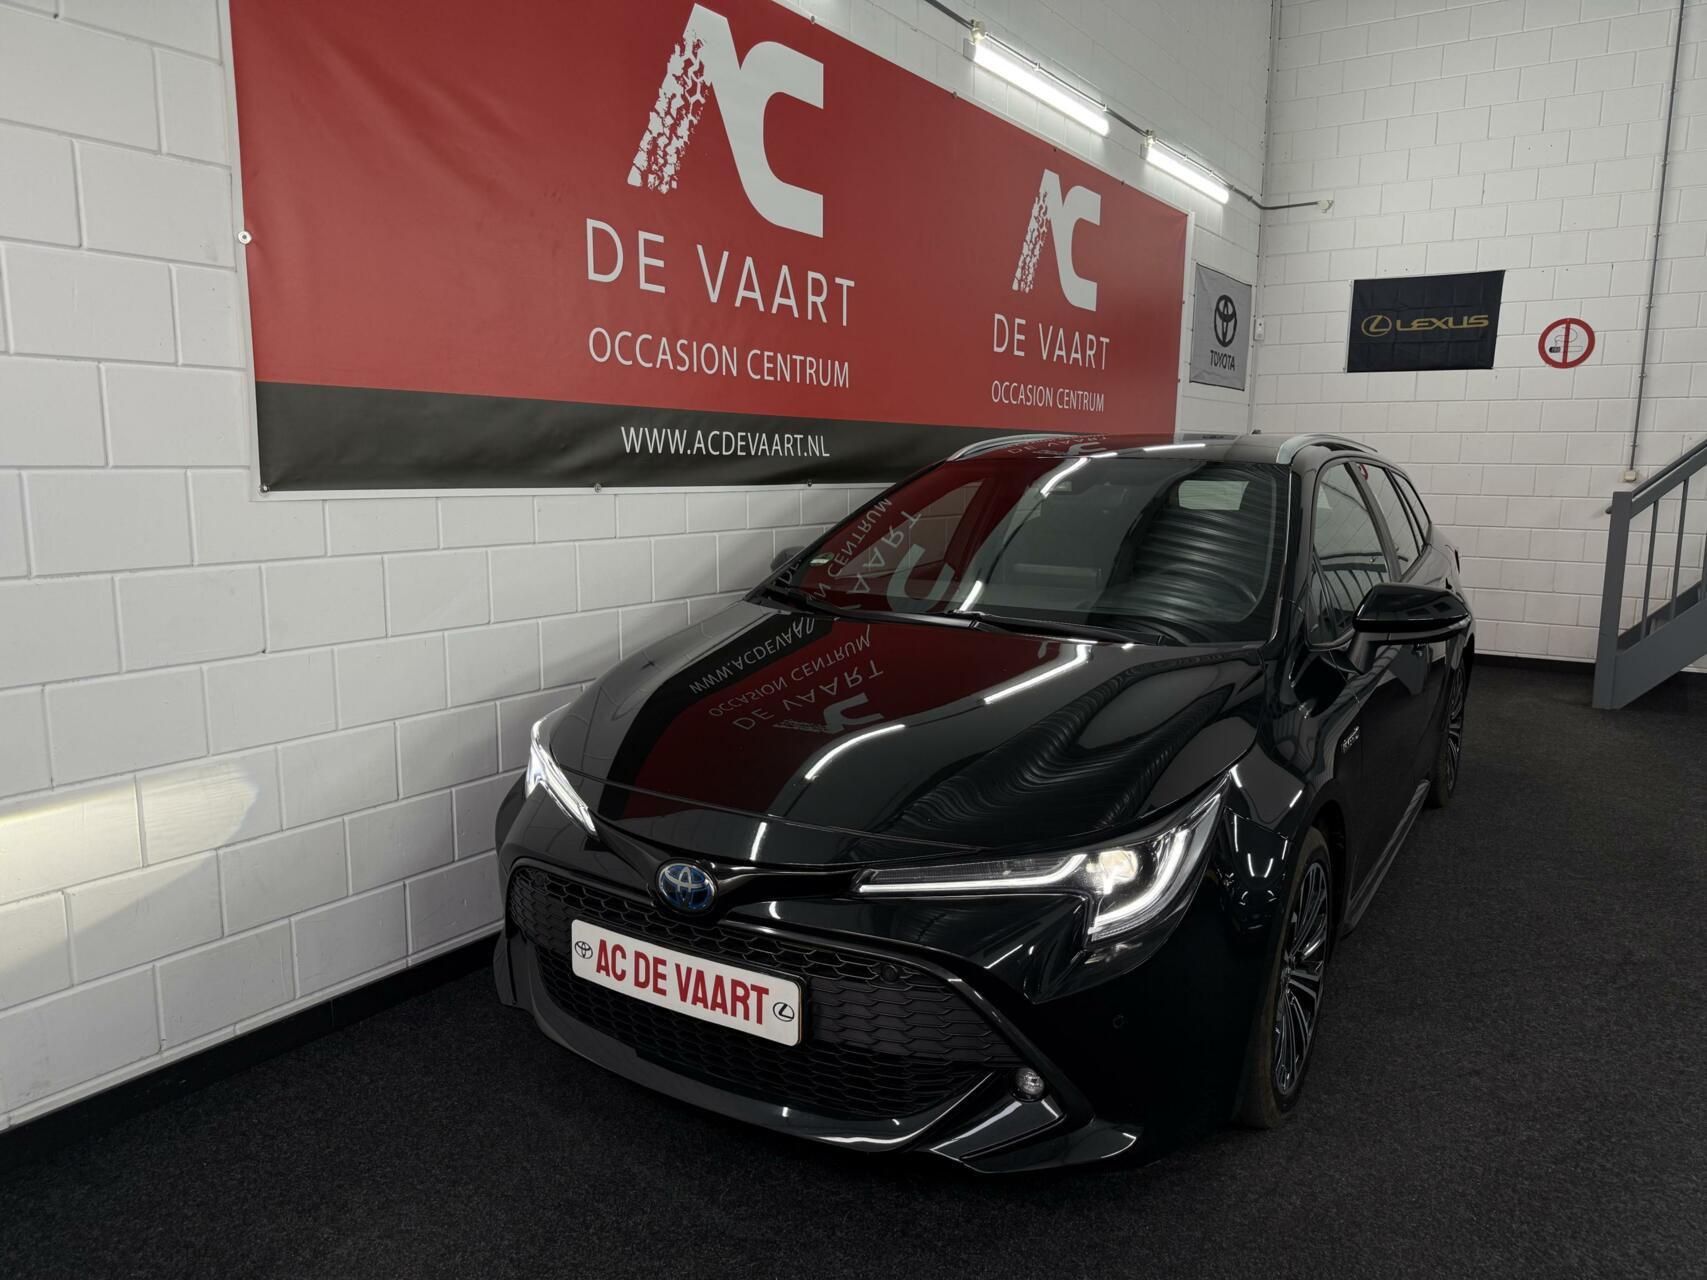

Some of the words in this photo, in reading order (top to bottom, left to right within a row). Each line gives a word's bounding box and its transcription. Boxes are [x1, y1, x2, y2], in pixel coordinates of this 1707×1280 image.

[586, 217, 666, 295] DE
[696, 243, 855, 327] VAART
[992, 313, 1026, 356] DE
[1038, 323, 1110, 371] VAART
[1396, 314, 1489, 331] LEXUS
[588, 327, 738, 377] OCCASION
[747, 348, 850, 389] CENTRUM
[1210, 349, 1236, 371] TOYOTA
[991, 380, 1054, 408] OCCASION
[1056, 389, 1105, 413] CENTRUM
[621, 425, 830, 457] WWW.ACDEVAART.NL
[596, 939, 627, 982] AC
[634, 950, 667, 997] DE
[674, 962, 769, 1025] VAART
